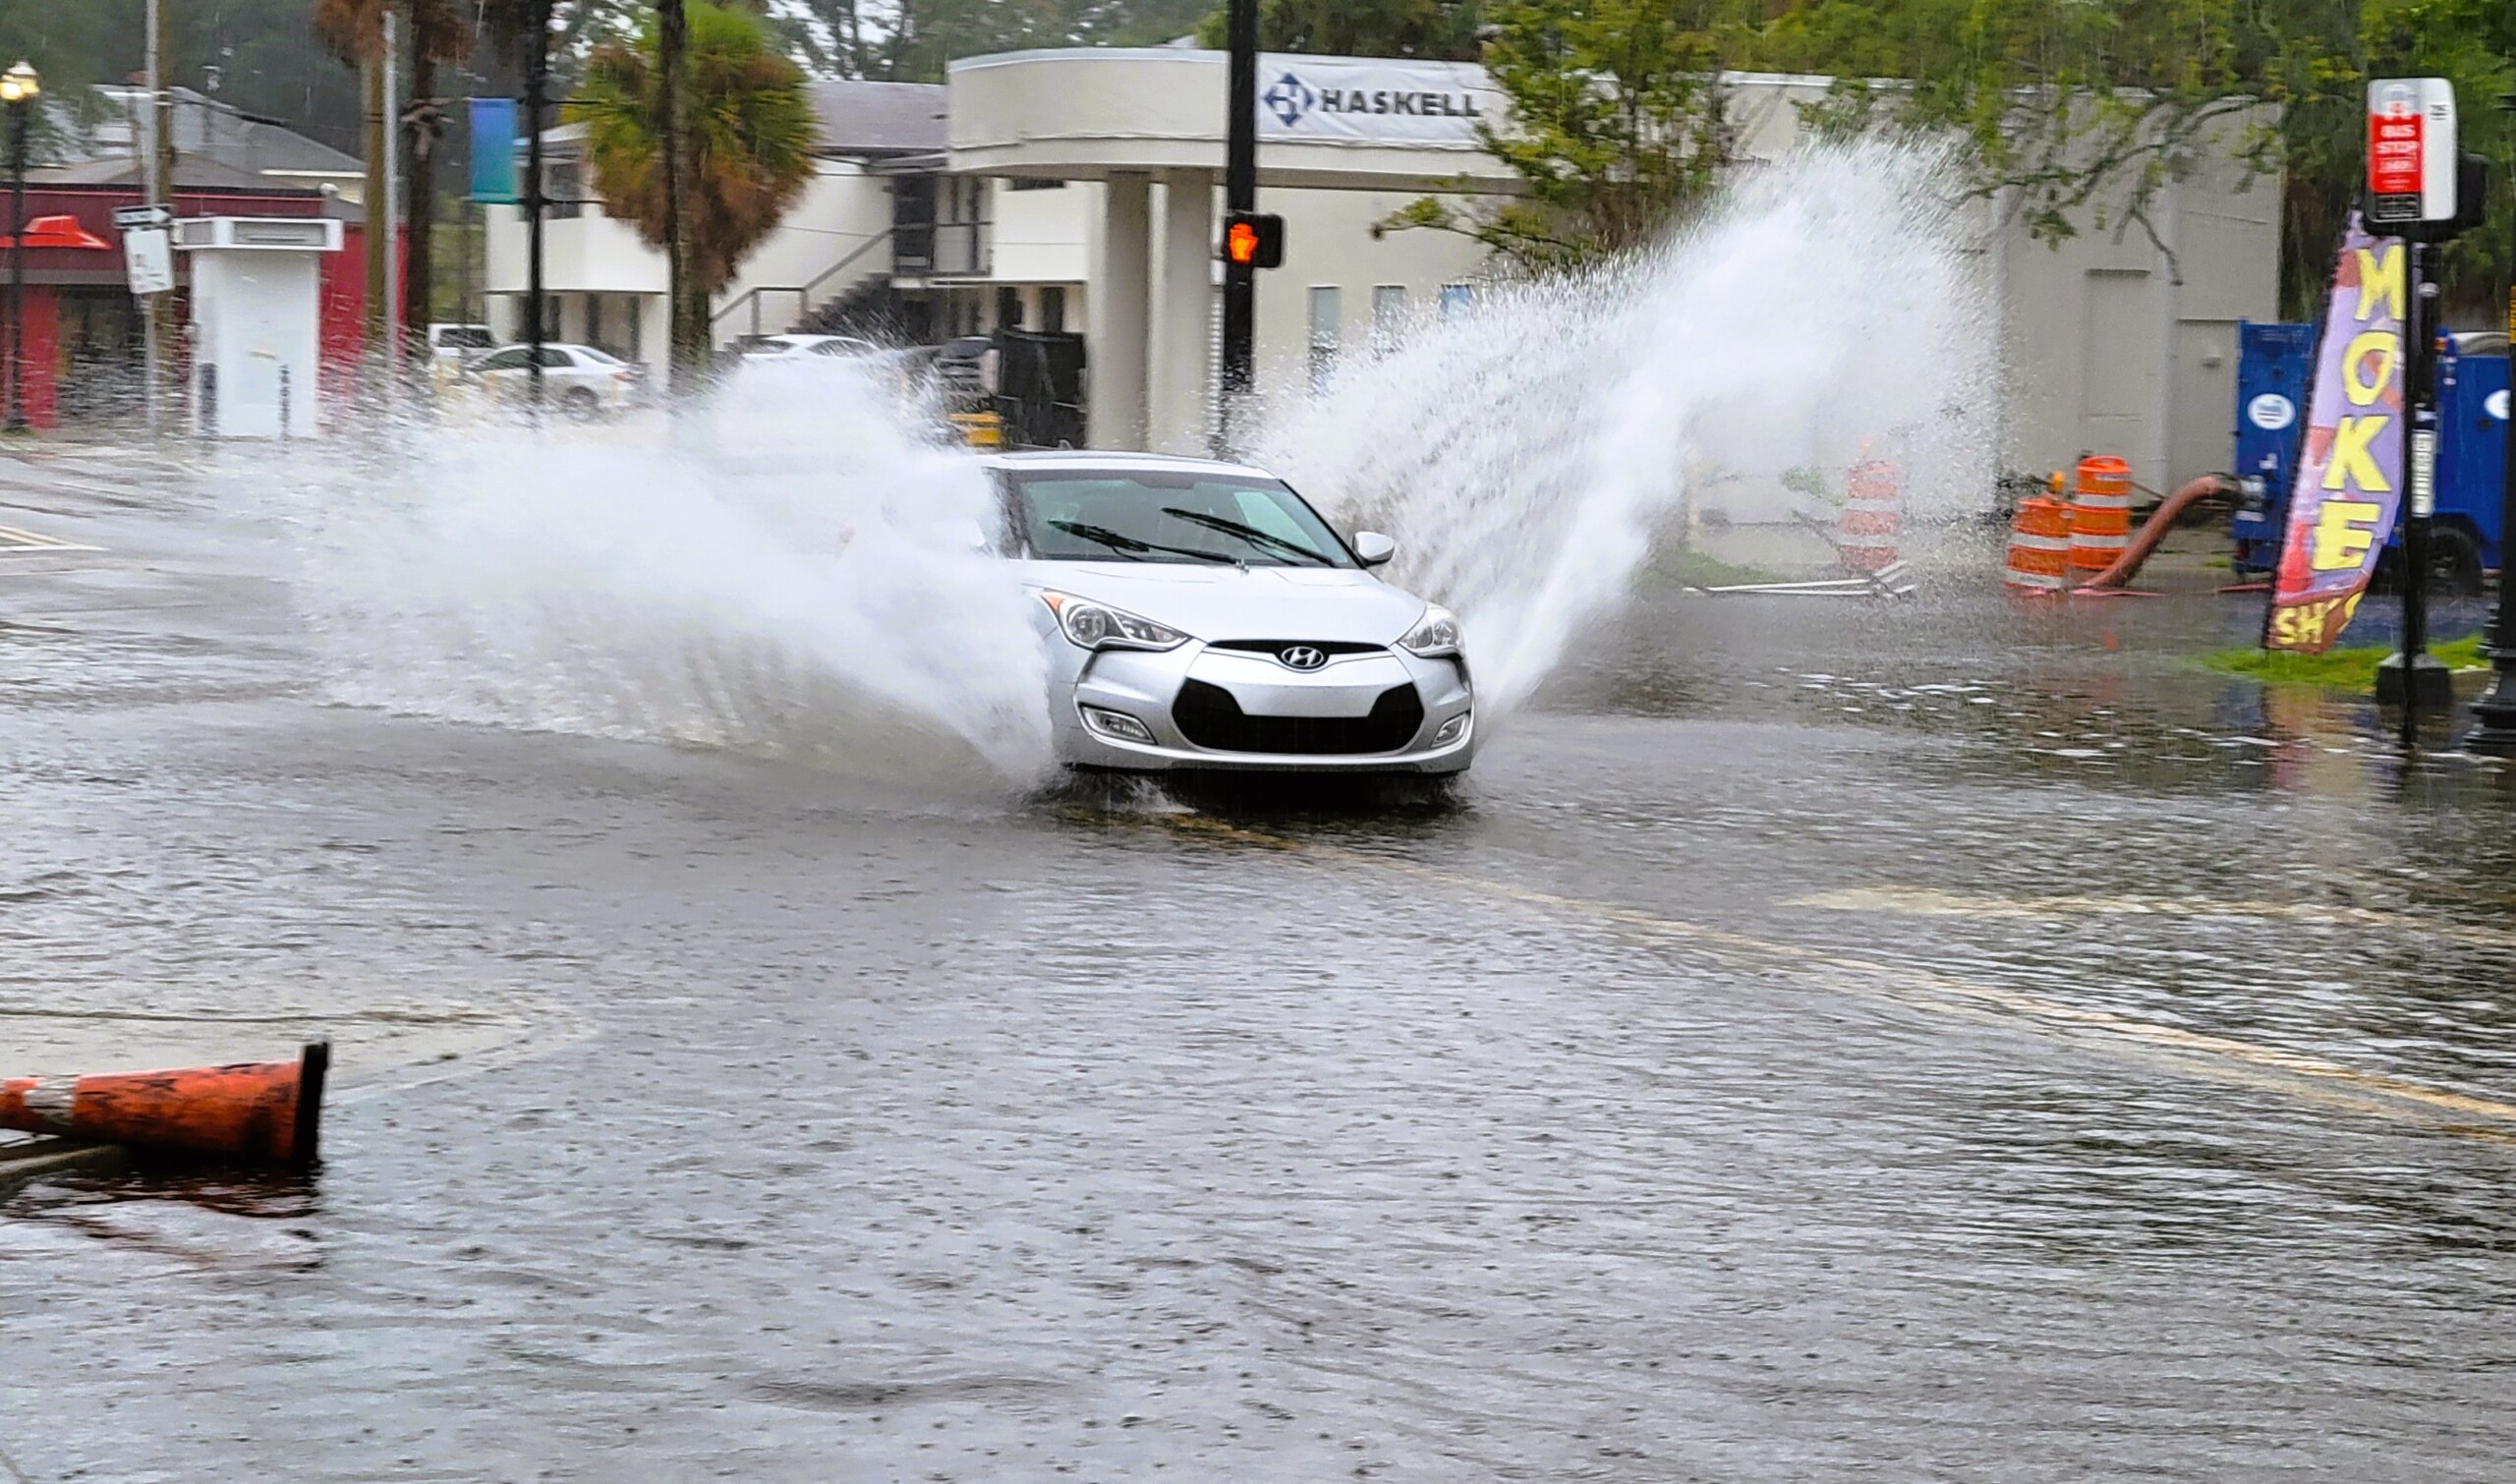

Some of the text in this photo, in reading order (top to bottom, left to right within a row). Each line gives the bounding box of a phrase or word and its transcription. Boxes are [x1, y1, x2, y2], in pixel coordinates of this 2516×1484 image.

[1320, 87, 1481, 117] HASKELL
[2380, 124, 2417, 138] BUS
[2375, 140, 2420, 154] STOP
[2313, 243, 2407, 572] MOKE
